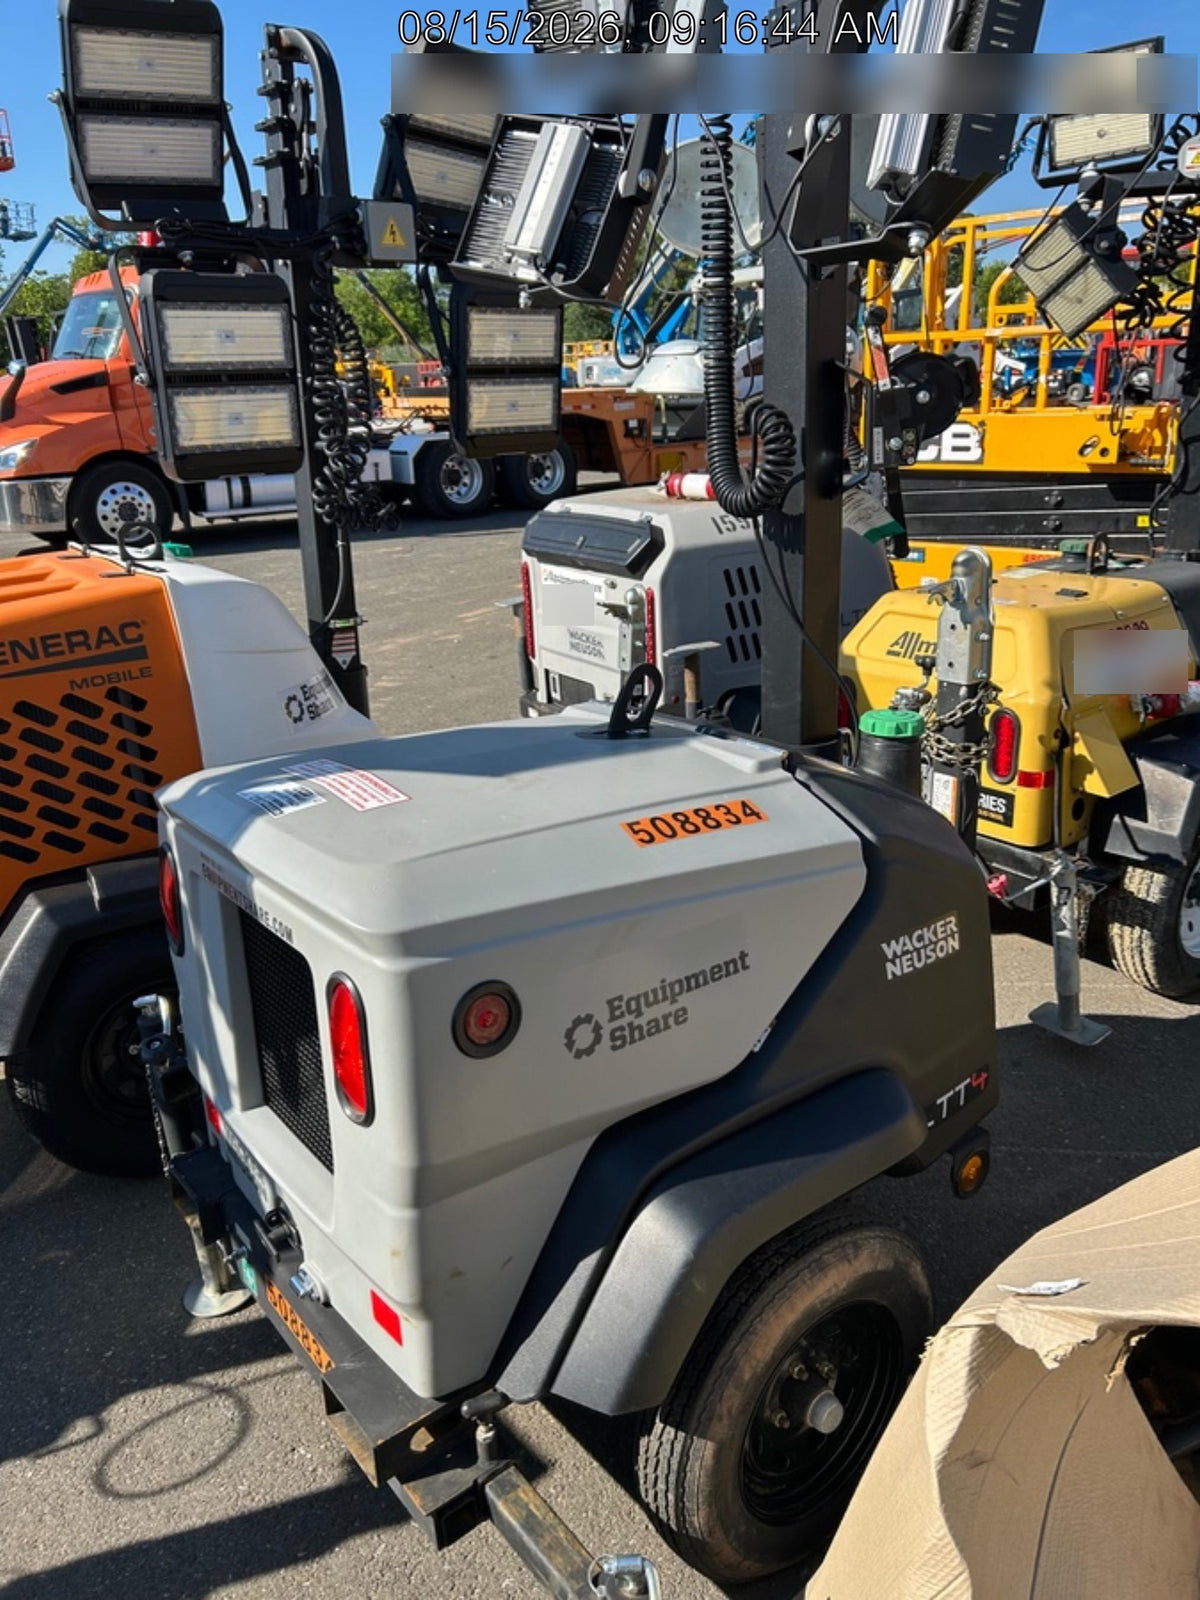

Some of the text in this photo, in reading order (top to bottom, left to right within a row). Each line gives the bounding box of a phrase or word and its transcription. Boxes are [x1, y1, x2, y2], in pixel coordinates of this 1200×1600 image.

[68, 666, 153, 691] MOBILE
[626, 799, 764, 845] 508834
[880, 916, 959, 960] WACKER
[884, 932, 960, 981] NEUSON
[606, 949, 751, 1023] Equipment
[609, 1006, 689, 1052] Share
[927, 1071, 989, 1128] TT4
